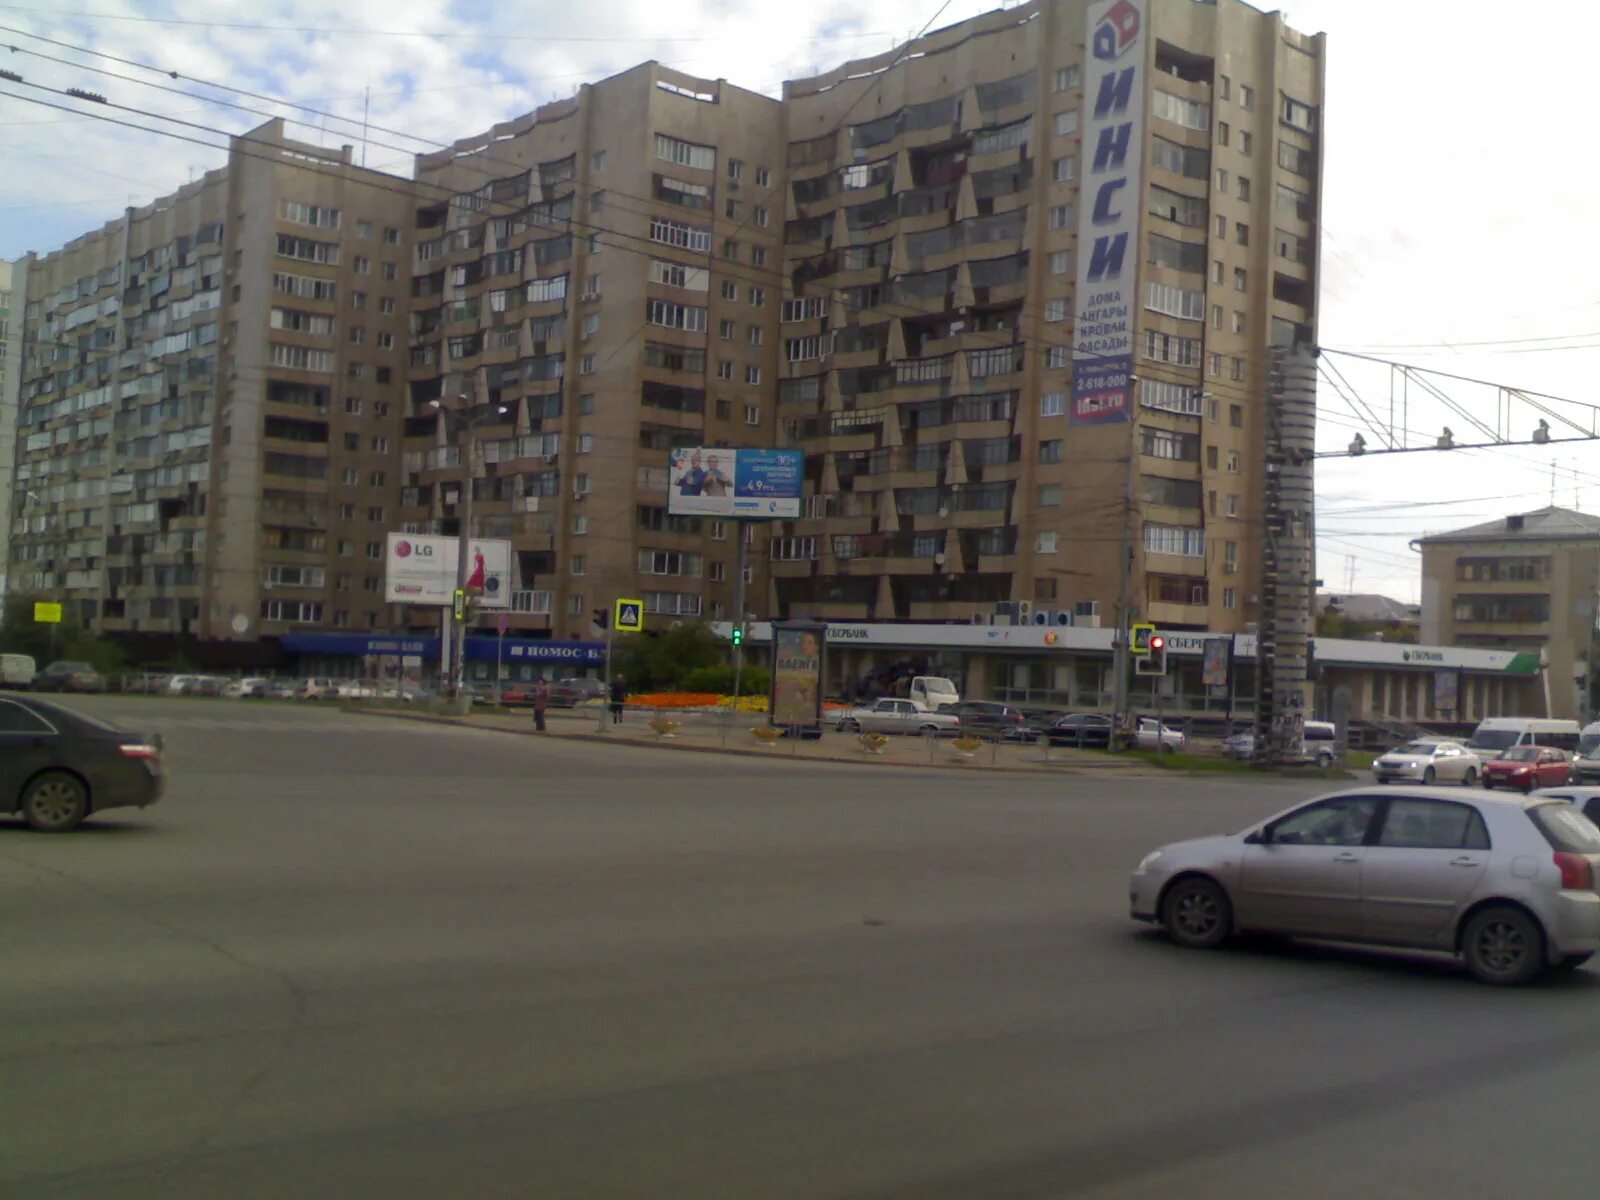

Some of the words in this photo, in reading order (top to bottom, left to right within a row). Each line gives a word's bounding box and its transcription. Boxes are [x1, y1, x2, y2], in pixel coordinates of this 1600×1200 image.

[1087, 66, 1135, 283] ИНСИ
[1087, 291, 1121, 307] ДОМА
[1080, 305, 1128, 321] АНГАРЫ
[1078, 336, 1128, 352] ФАСАДЫ
[414, 544, 433, 556] LG
